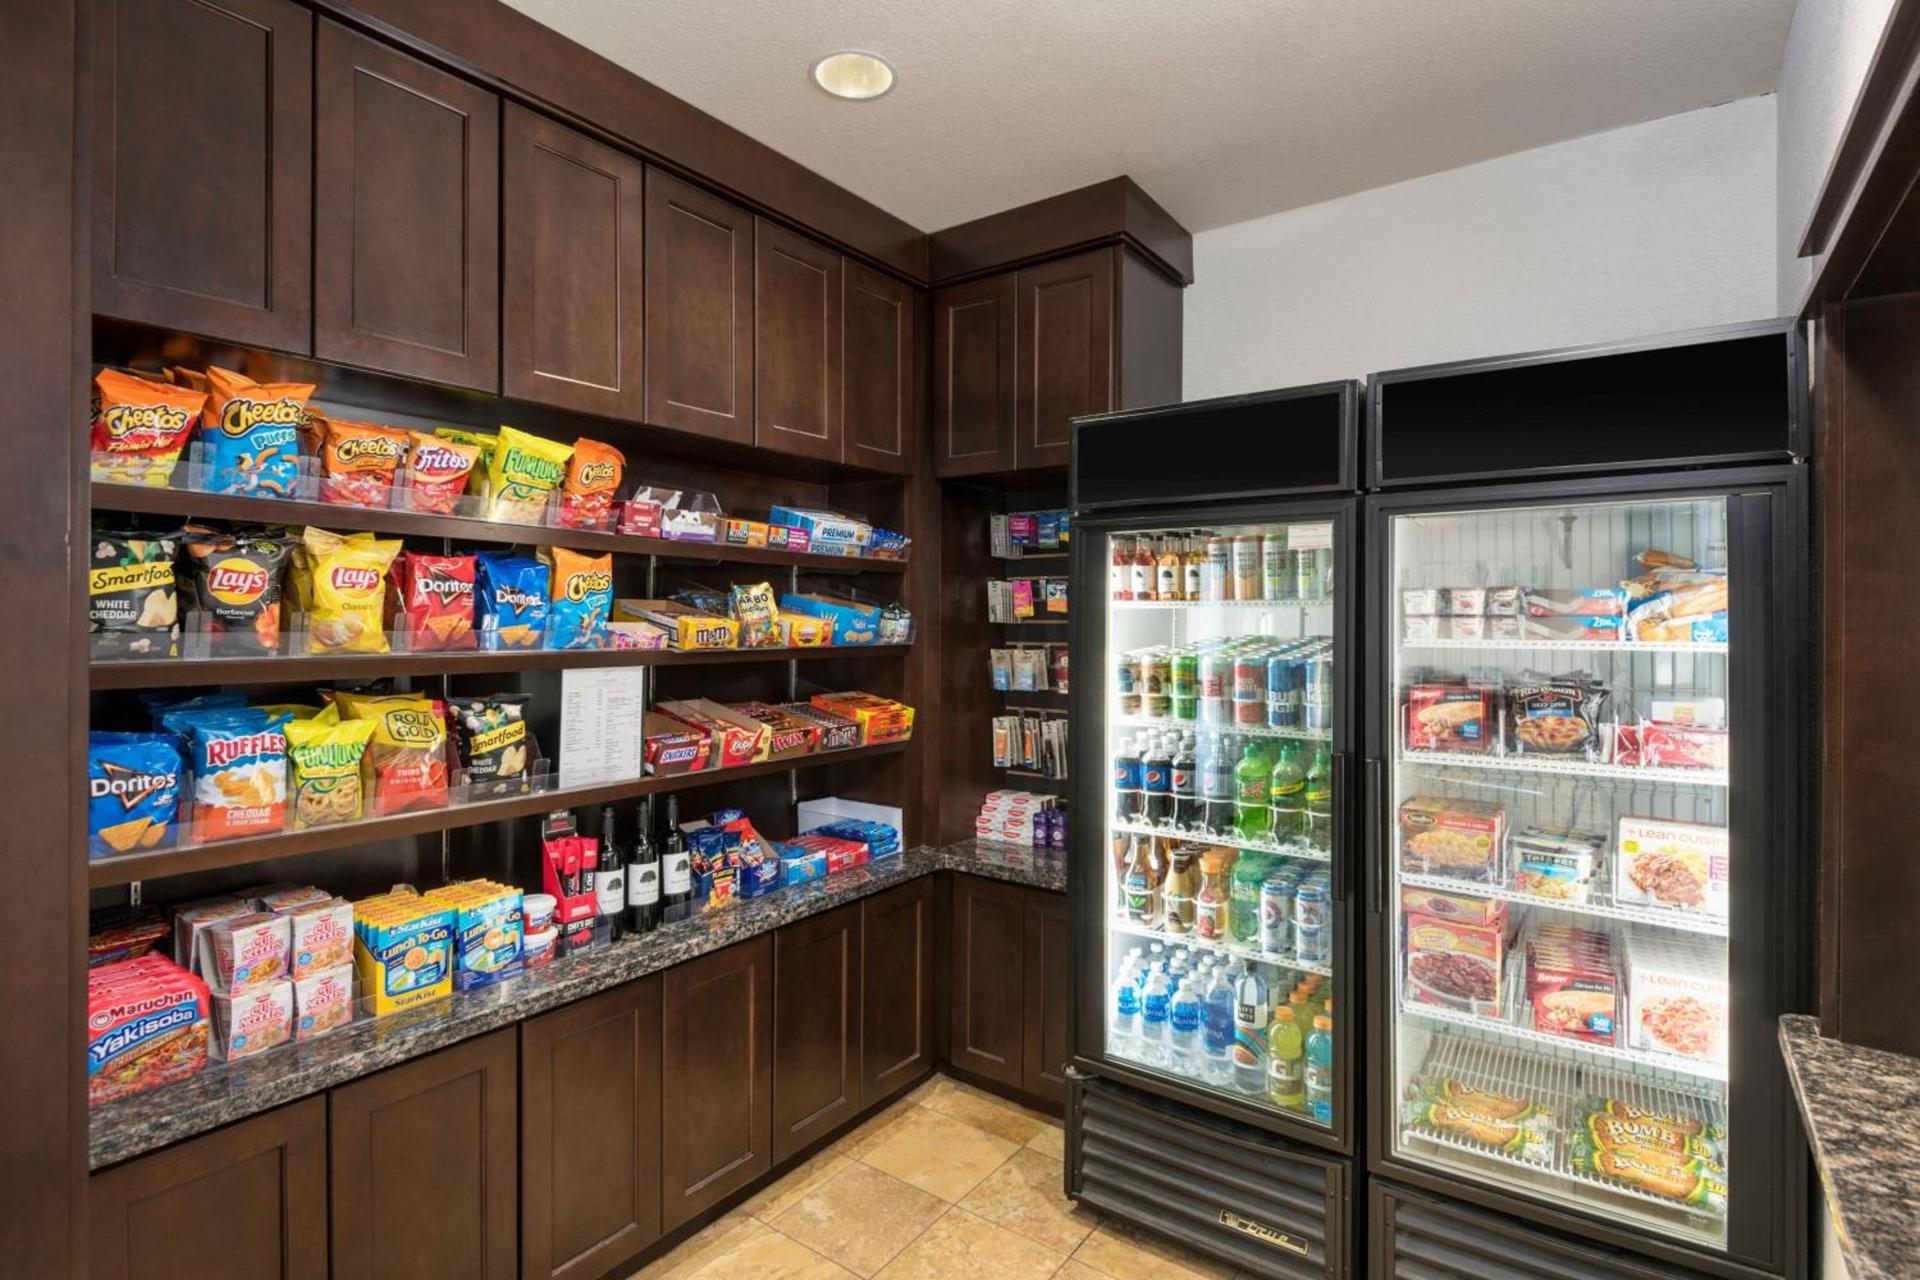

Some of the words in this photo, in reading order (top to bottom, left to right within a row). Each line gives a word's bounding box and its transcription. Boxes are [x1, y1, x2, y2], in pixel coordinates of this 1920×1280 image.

[104, 404, 187, 437] Cheetos
[337, 437, 400, 462] Cheetos
[415, 447, 468, 471] Fritos
[580, 463, 615, 487] Cheetos
[822, 527, 855, 540] PREMIUM
[566, 572, 612, 602] Cheetos
[90, 610, 137, 620] CHEDDAR
[96, 600, 131, 610] WHITE
[393, 713, 430, 727] ROLD
[396, 726, 435, 739] GOLD
[207, 733, 287, 767] RUFFLES
[662, 748, 697, 761] SNICKERS
[91, 772, 176, 798] Doritos
[226, 808, 272, 820] CHEDDAR
[382, 936, 416, 961] Lunch
[418, 929, 449, 946] To-Go
[110, 990, 193, 1018] Maruchan
[94, 1009, 195, 1061] Yakisoba
[1606, 1119, 1677, 1144] BOMB
